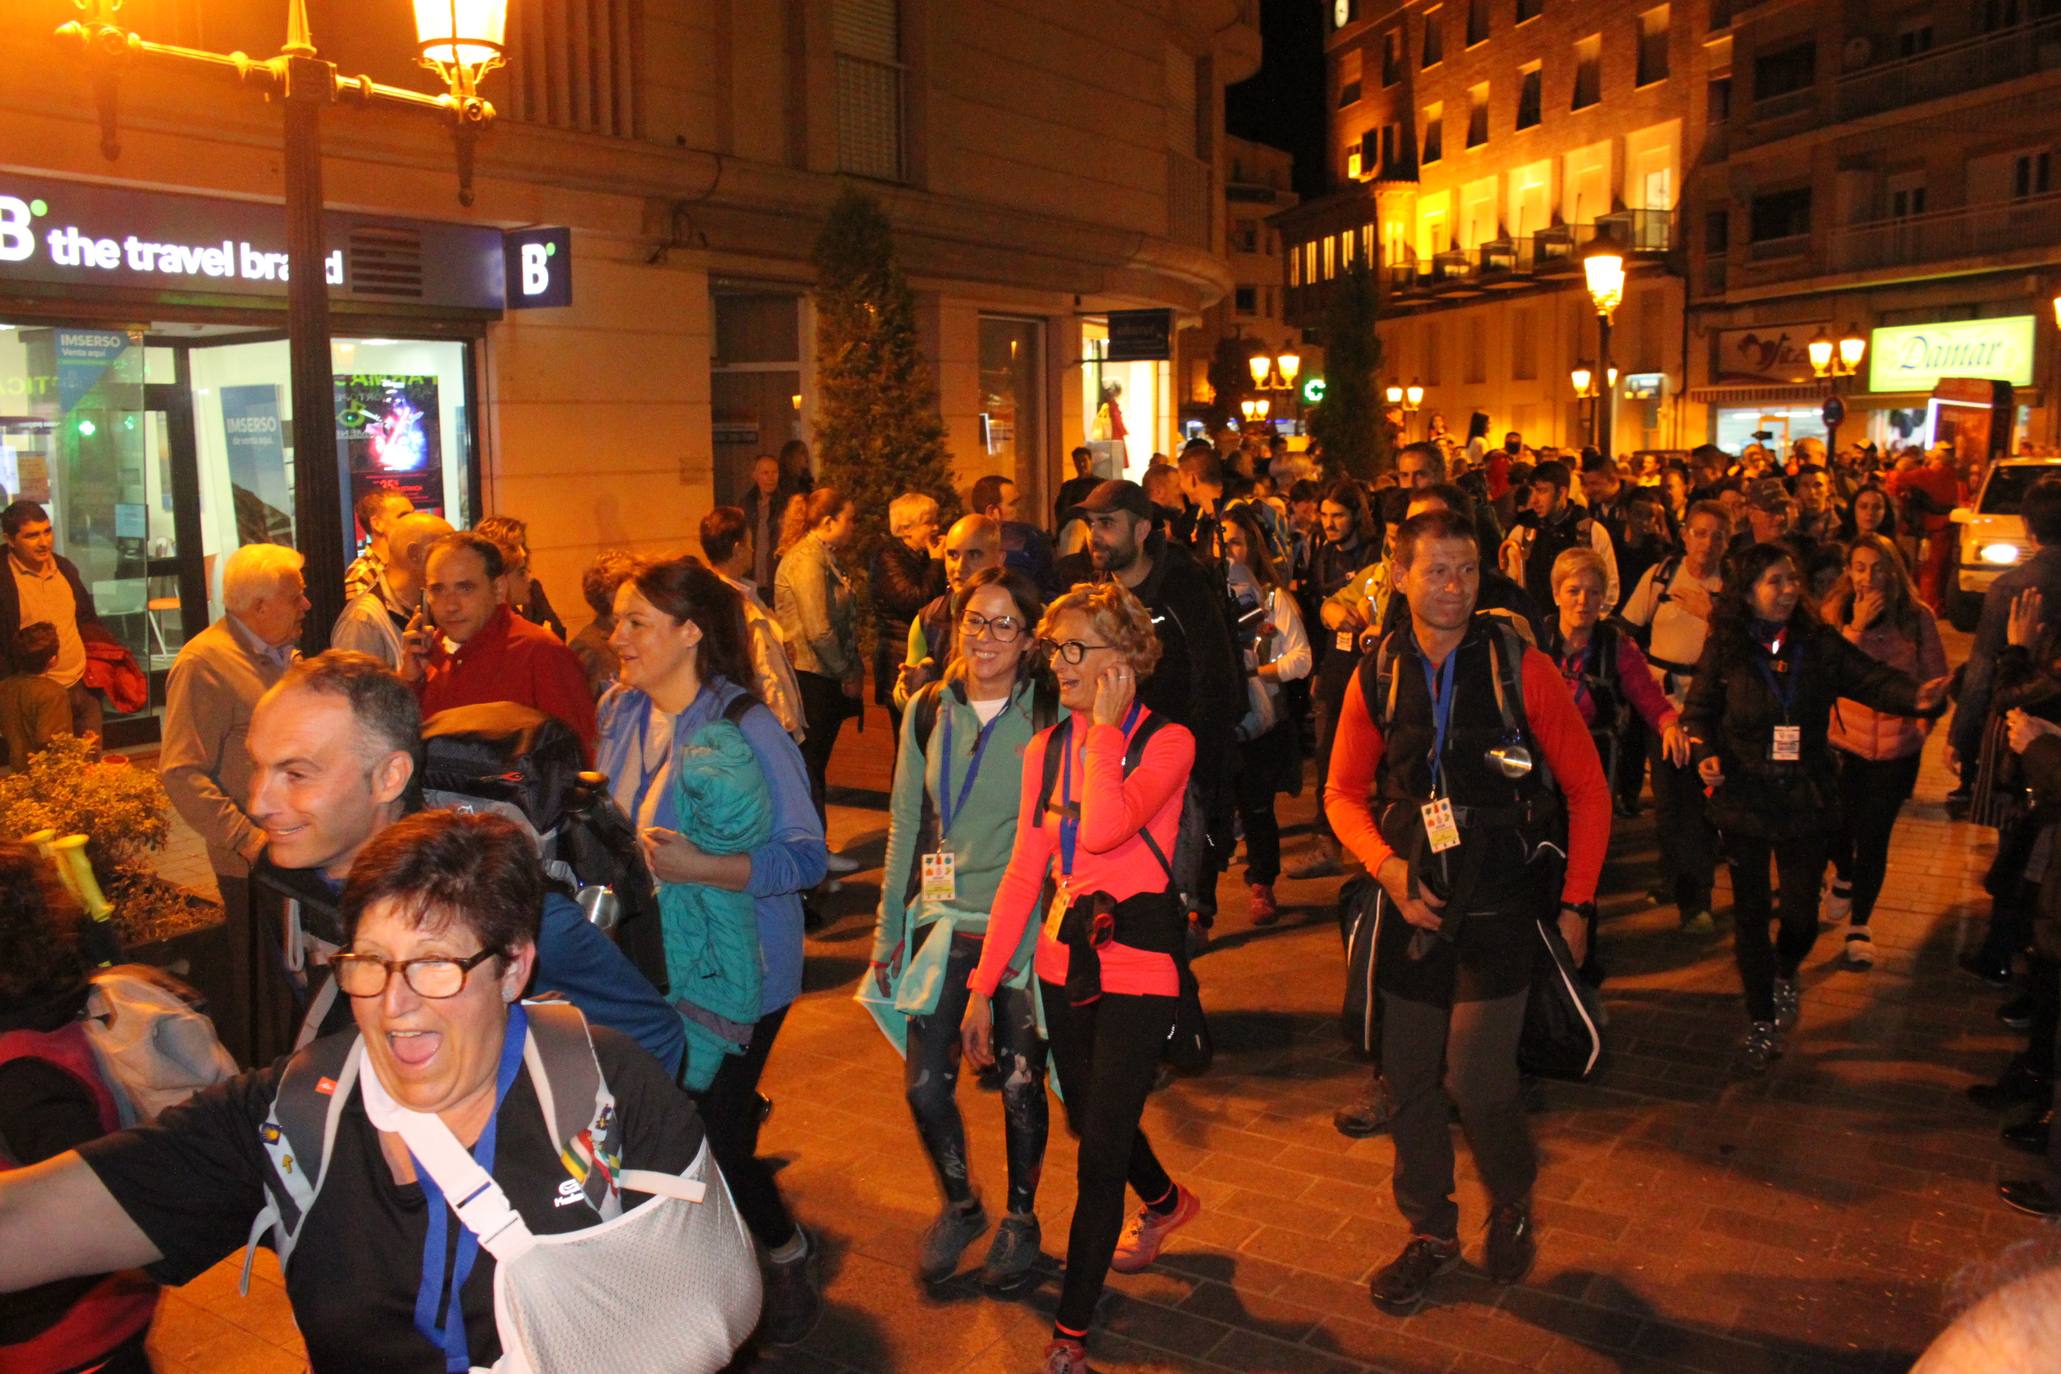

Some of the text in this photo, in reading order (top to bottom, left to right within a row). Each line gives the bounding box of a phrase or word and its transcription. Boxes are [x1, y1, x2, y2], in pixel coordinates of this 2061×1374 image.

[0, 195, 36, 262] B
[47, 226, 344, 285] the travel brd
[521, 243, 549, 296] B
[60, 333, 121, 348] IMSERSO
[62, 347, 89, 358] Venta
[1900, 335, 2004, 369] Damar
[226, 415, 277, 433] IMSERSO
